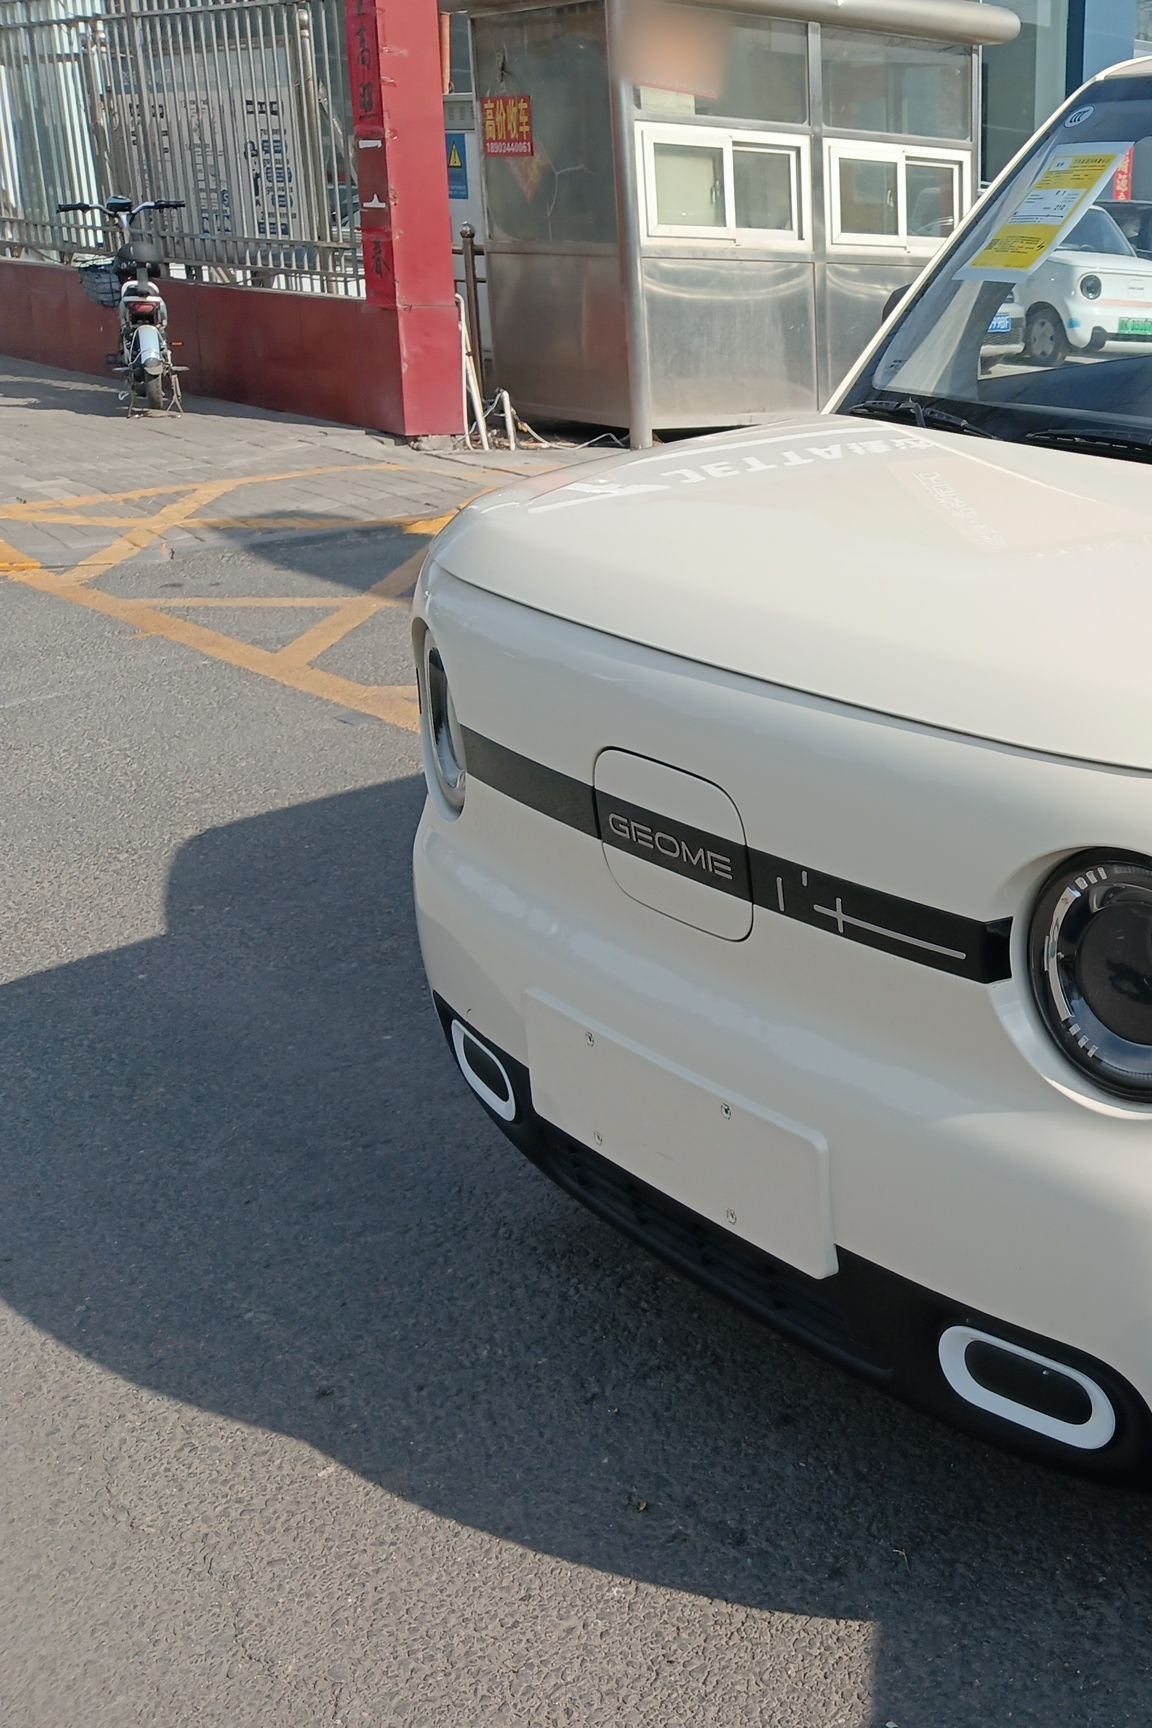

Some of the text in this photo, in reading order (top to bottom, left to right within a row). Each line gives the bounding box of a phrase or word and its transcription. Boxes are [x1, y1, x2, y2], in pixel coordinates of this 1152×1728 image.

[484, 98, 530, 140] 高价收车
[608, 813, 733, 880] GEOME
